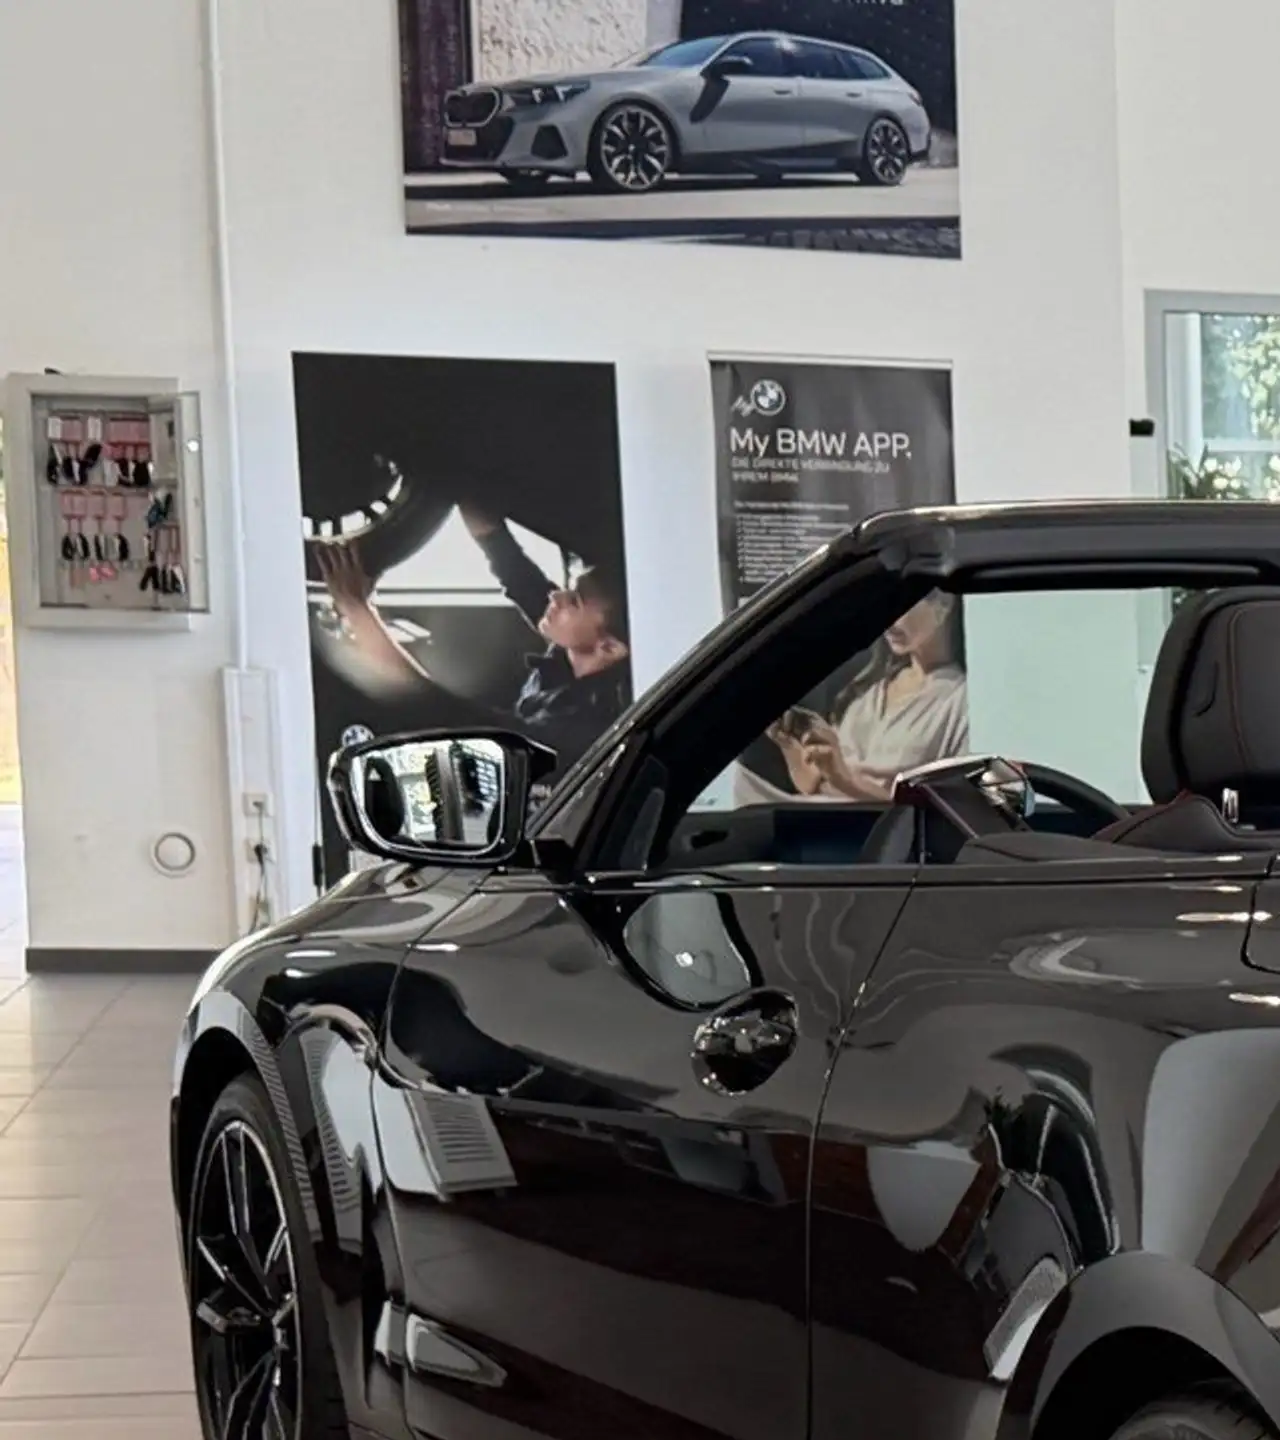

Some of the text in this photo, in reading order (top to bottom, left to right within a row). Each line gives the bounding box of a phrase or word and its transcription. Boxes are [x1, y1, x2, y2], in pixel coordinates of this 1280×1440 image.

[730, 427, 912, 460] My BMW APP.
